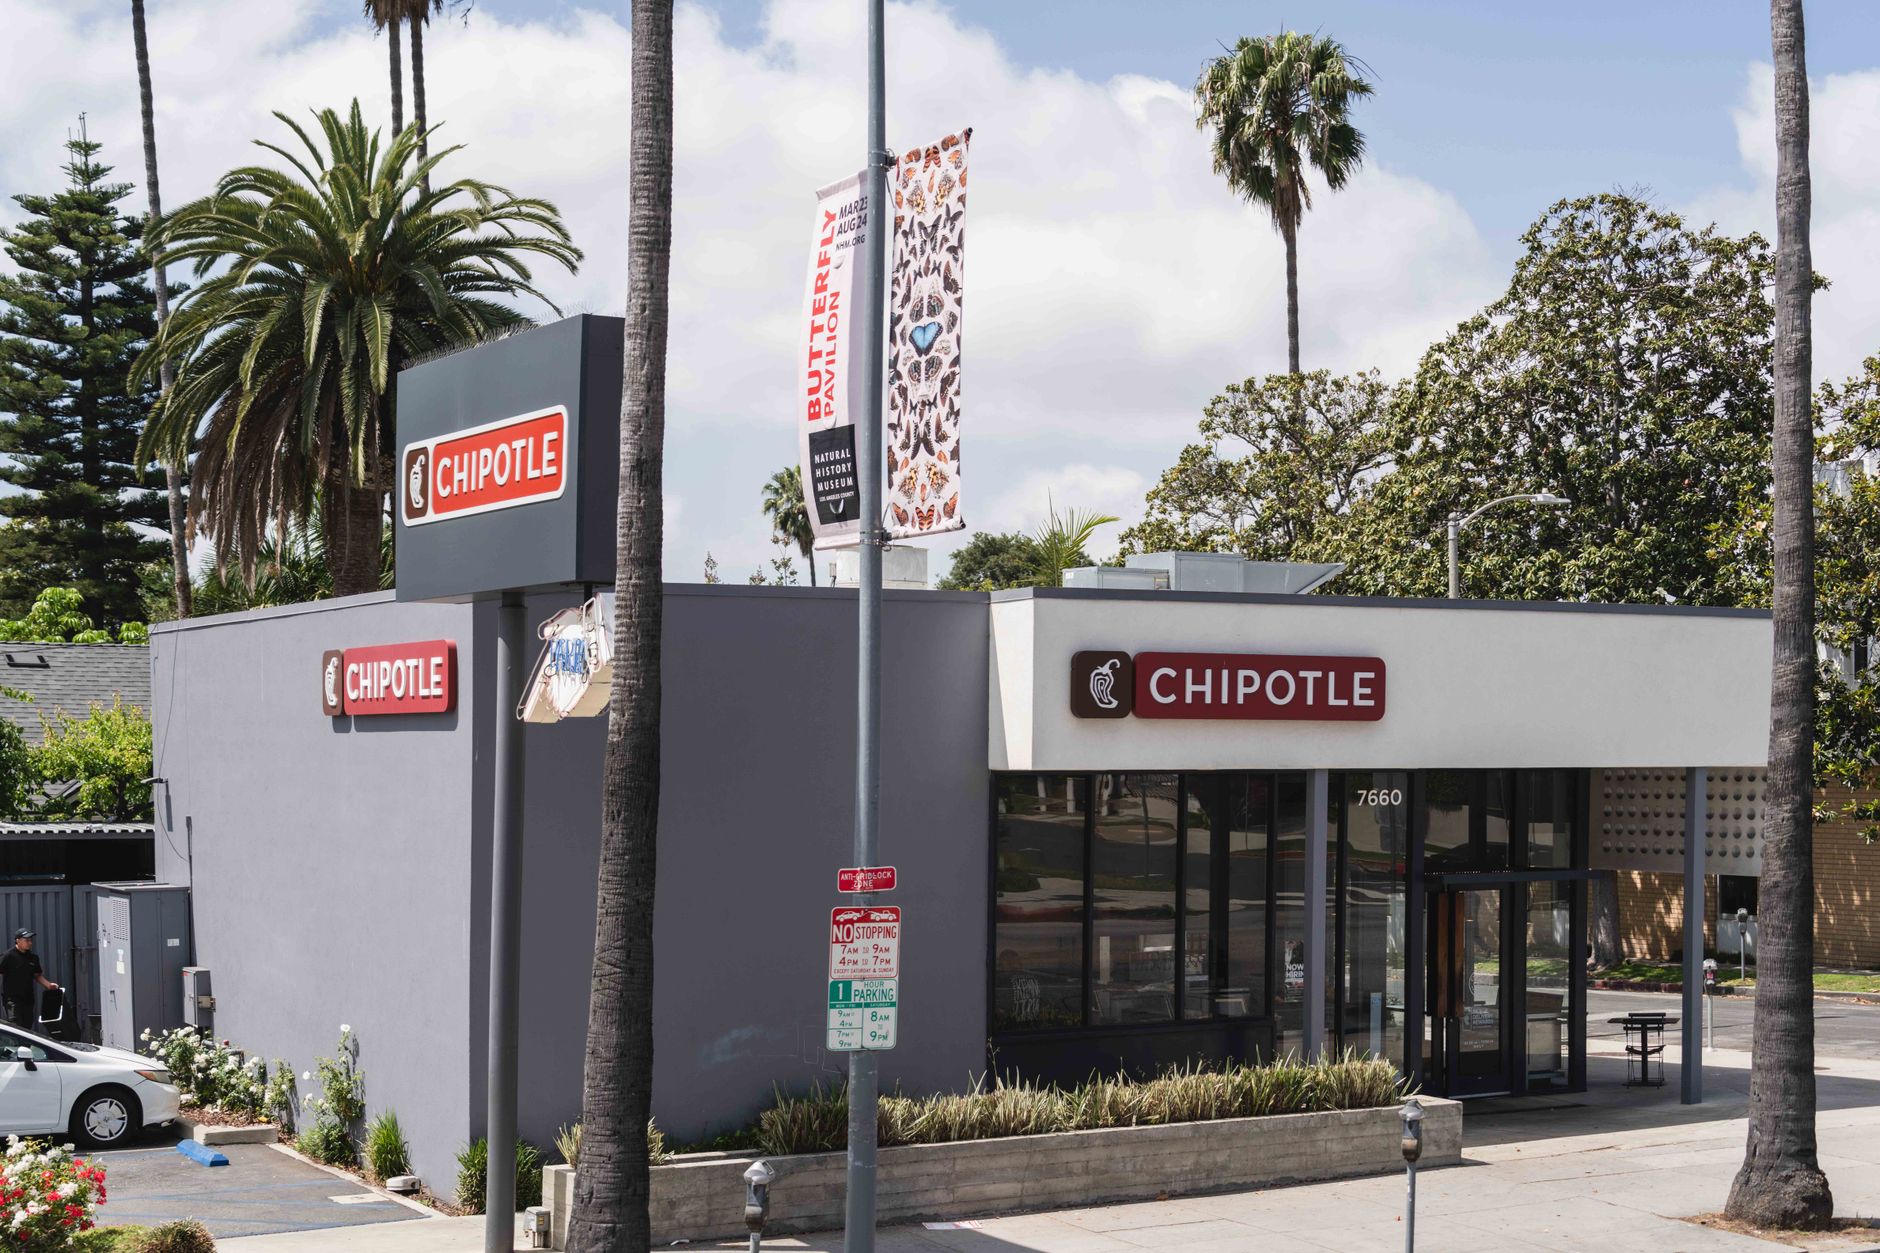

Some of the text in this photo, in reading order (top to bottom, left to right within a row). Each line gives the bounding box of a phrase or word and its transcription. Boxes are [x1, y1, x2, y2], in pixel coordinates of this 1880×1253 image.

[836, 234, 865, 251] NHM.ORG
[808, 210, 836, 421] BUTTERFLY
[824, 291, 840, 417] PAVILION
[815, 448, 850, 464] NATURAL
[437, 431, 558, 498] CHIPOTLE
[816, 463, 852, 477] HISTORY
[818, 477, 853, 491] MUSEUM
[346, 657, 443, 700] CHIPOTLE
[1150, 668, 1375, 706] CHIPOTLE
[1357, 790, 1402, 806] 7660
[841, 871, 892, 880] ANTI-GRIDLOCK
[853, 880, 873, 888] ZONE
[833, 924, 896, 943] NO STOPPING
[1286, 963, 1304, 971] NOW
[838, 983, 843, 1000] 1
[854, 988, 894, 1002] PARKING
